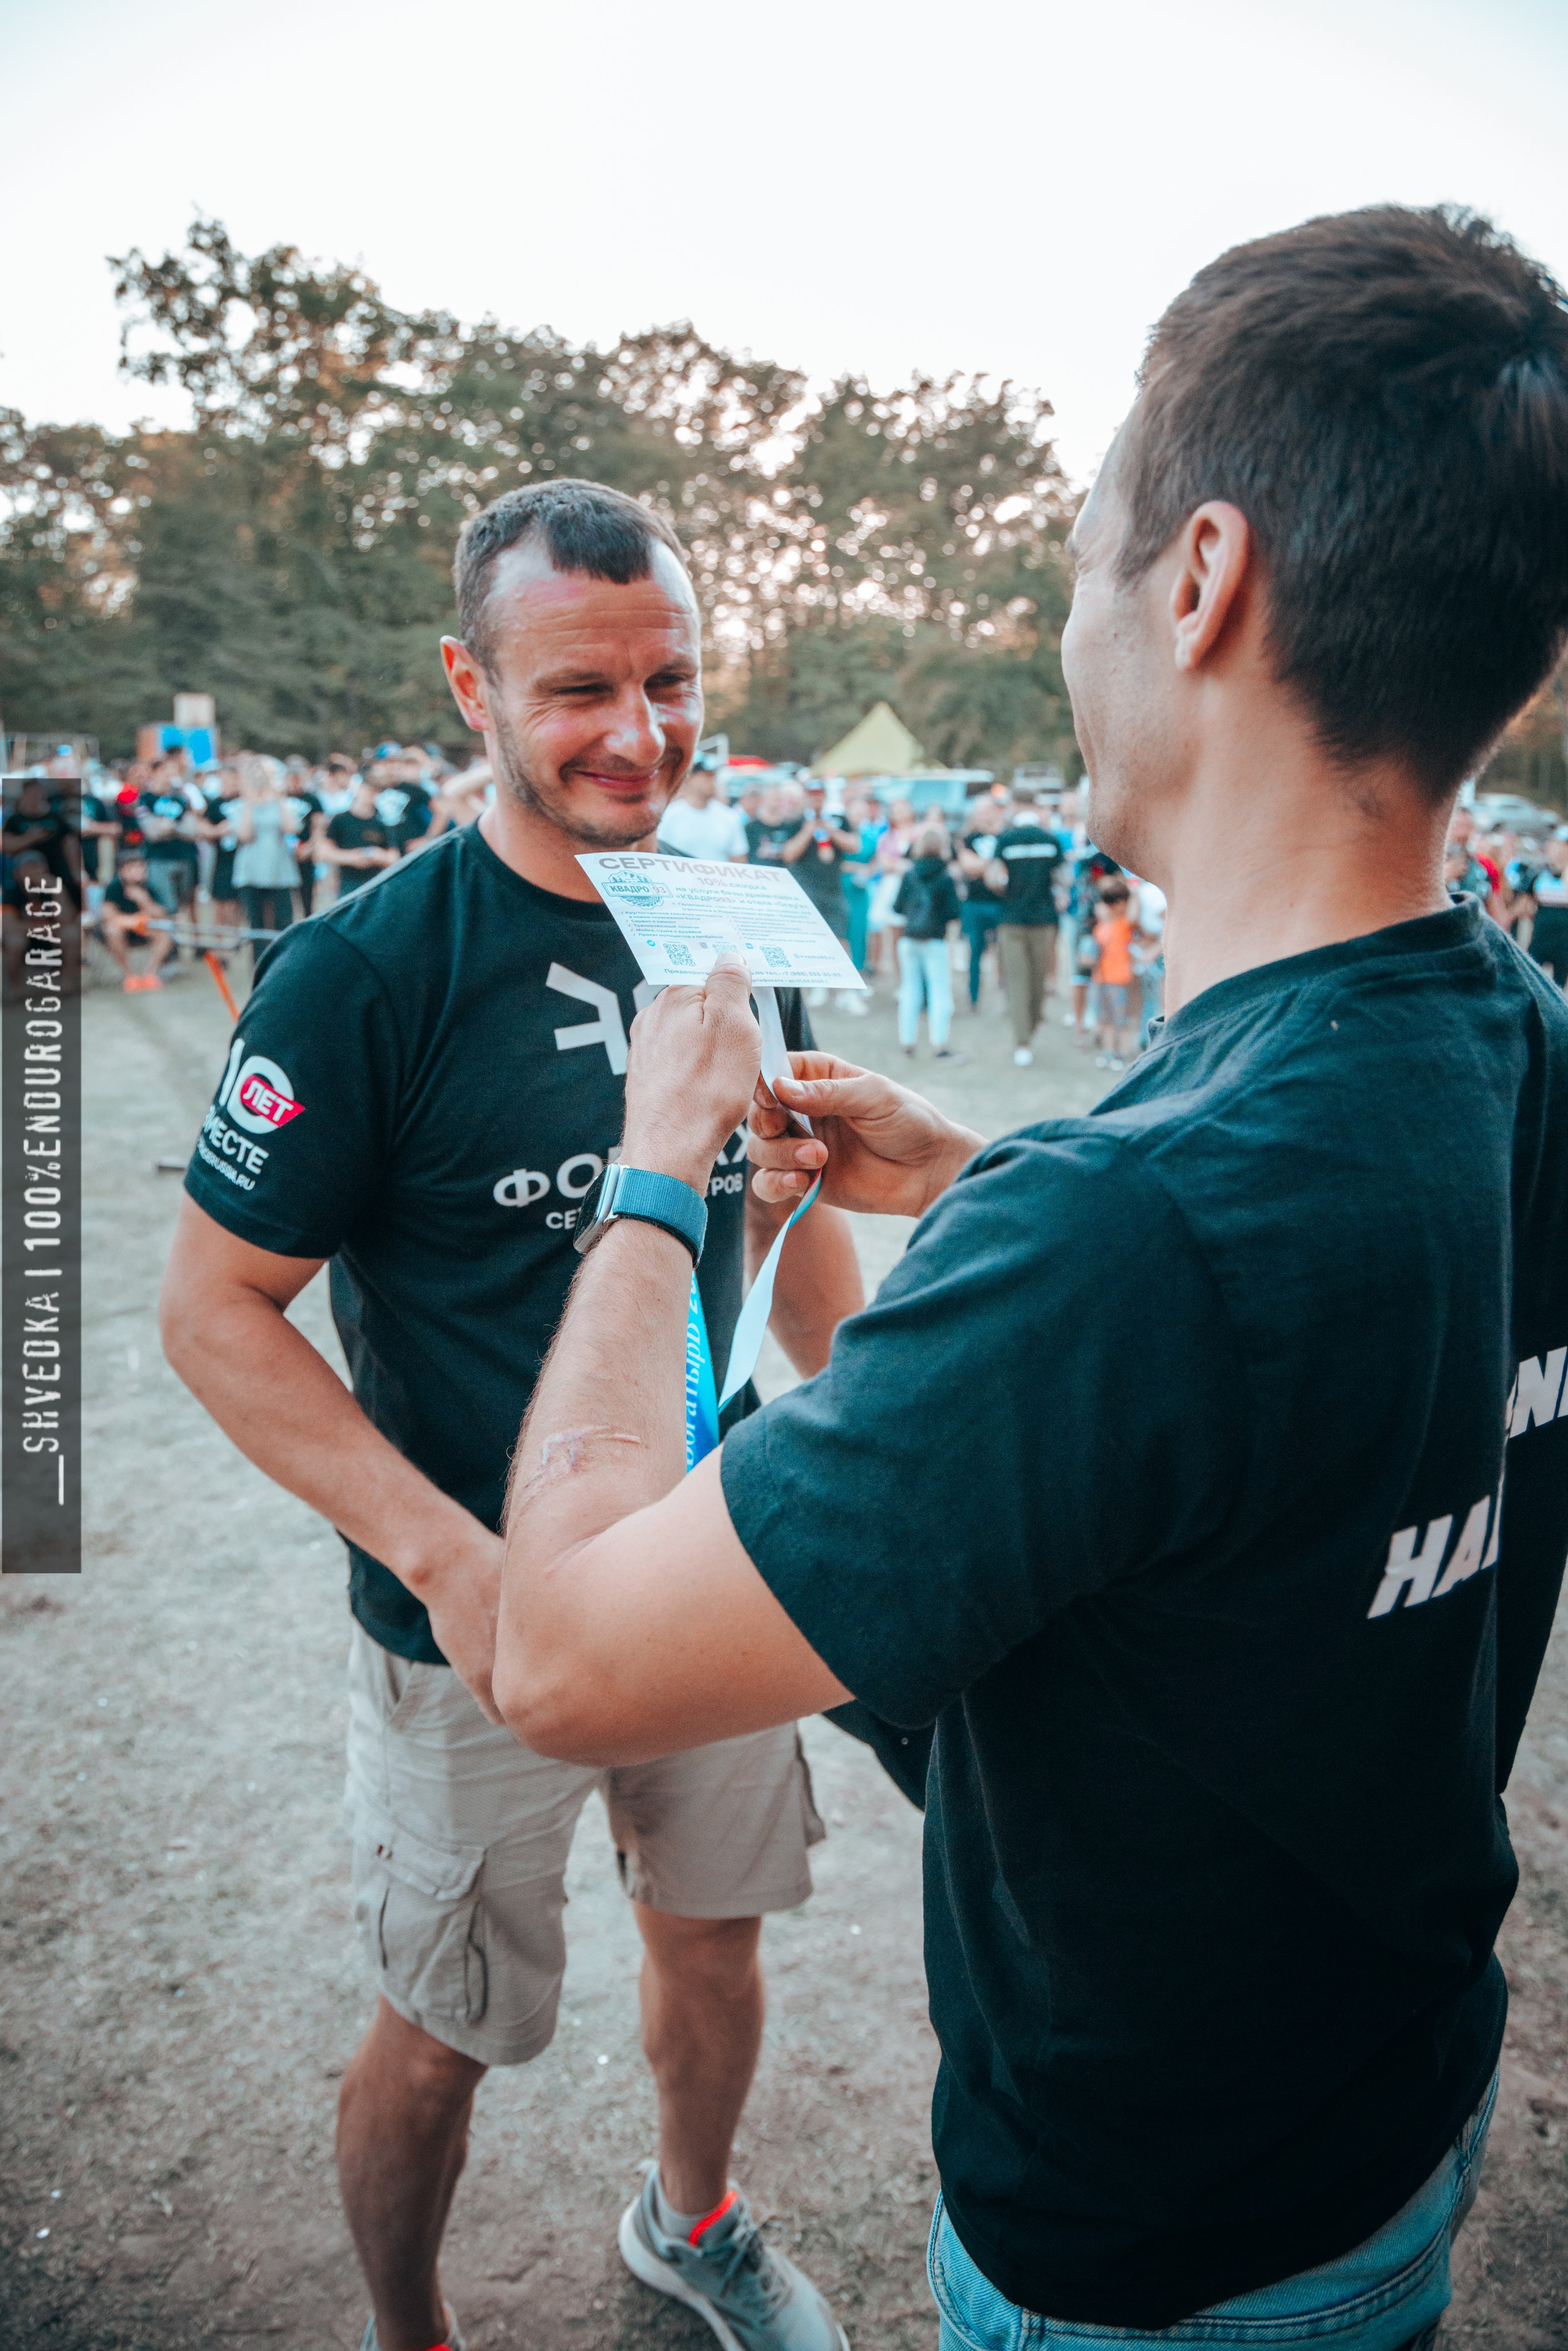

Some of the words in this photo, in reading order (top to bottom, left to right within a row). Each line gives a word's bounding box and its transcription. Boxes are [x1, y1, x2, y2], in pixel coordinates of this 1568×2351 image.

[598, 857, 781, 882] СЕРТИФИКАТ
[697, 877, 728, 888] 10%
[729, 882, 767, 891] скидка
[243, 1080, 294, 1122] ЛЕТ
[546, 1206, 582, 1229] СЕ
